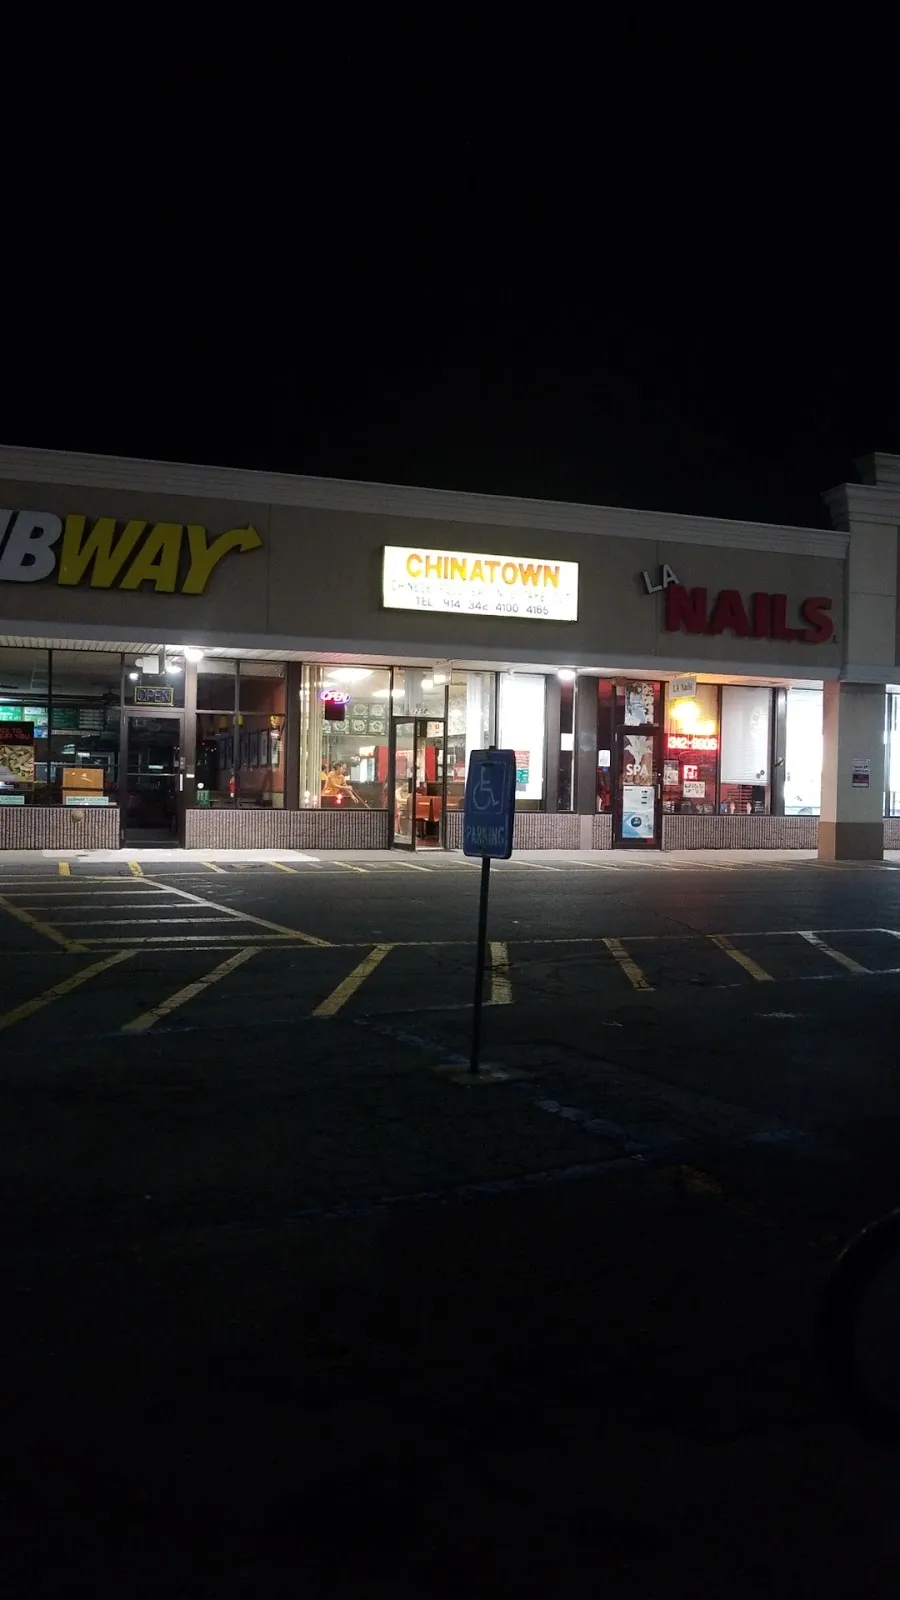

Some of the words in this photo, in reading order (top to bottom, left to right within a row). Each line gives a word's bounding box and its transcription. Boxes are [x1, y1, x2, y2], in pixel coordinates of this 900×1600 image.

[0, 509, 262, 594] BWAY
[406, 553, 561, 588] CHINATOWN
[643, 563, 679, 594] LA
[416, 596, 433, 607] TEL
[496, 603, 519, 613] 4100
[664, 585, 834, 643] NAILS
[137, 688, 171, 703] OPEN
[626, 763, 649, 776] SPA
